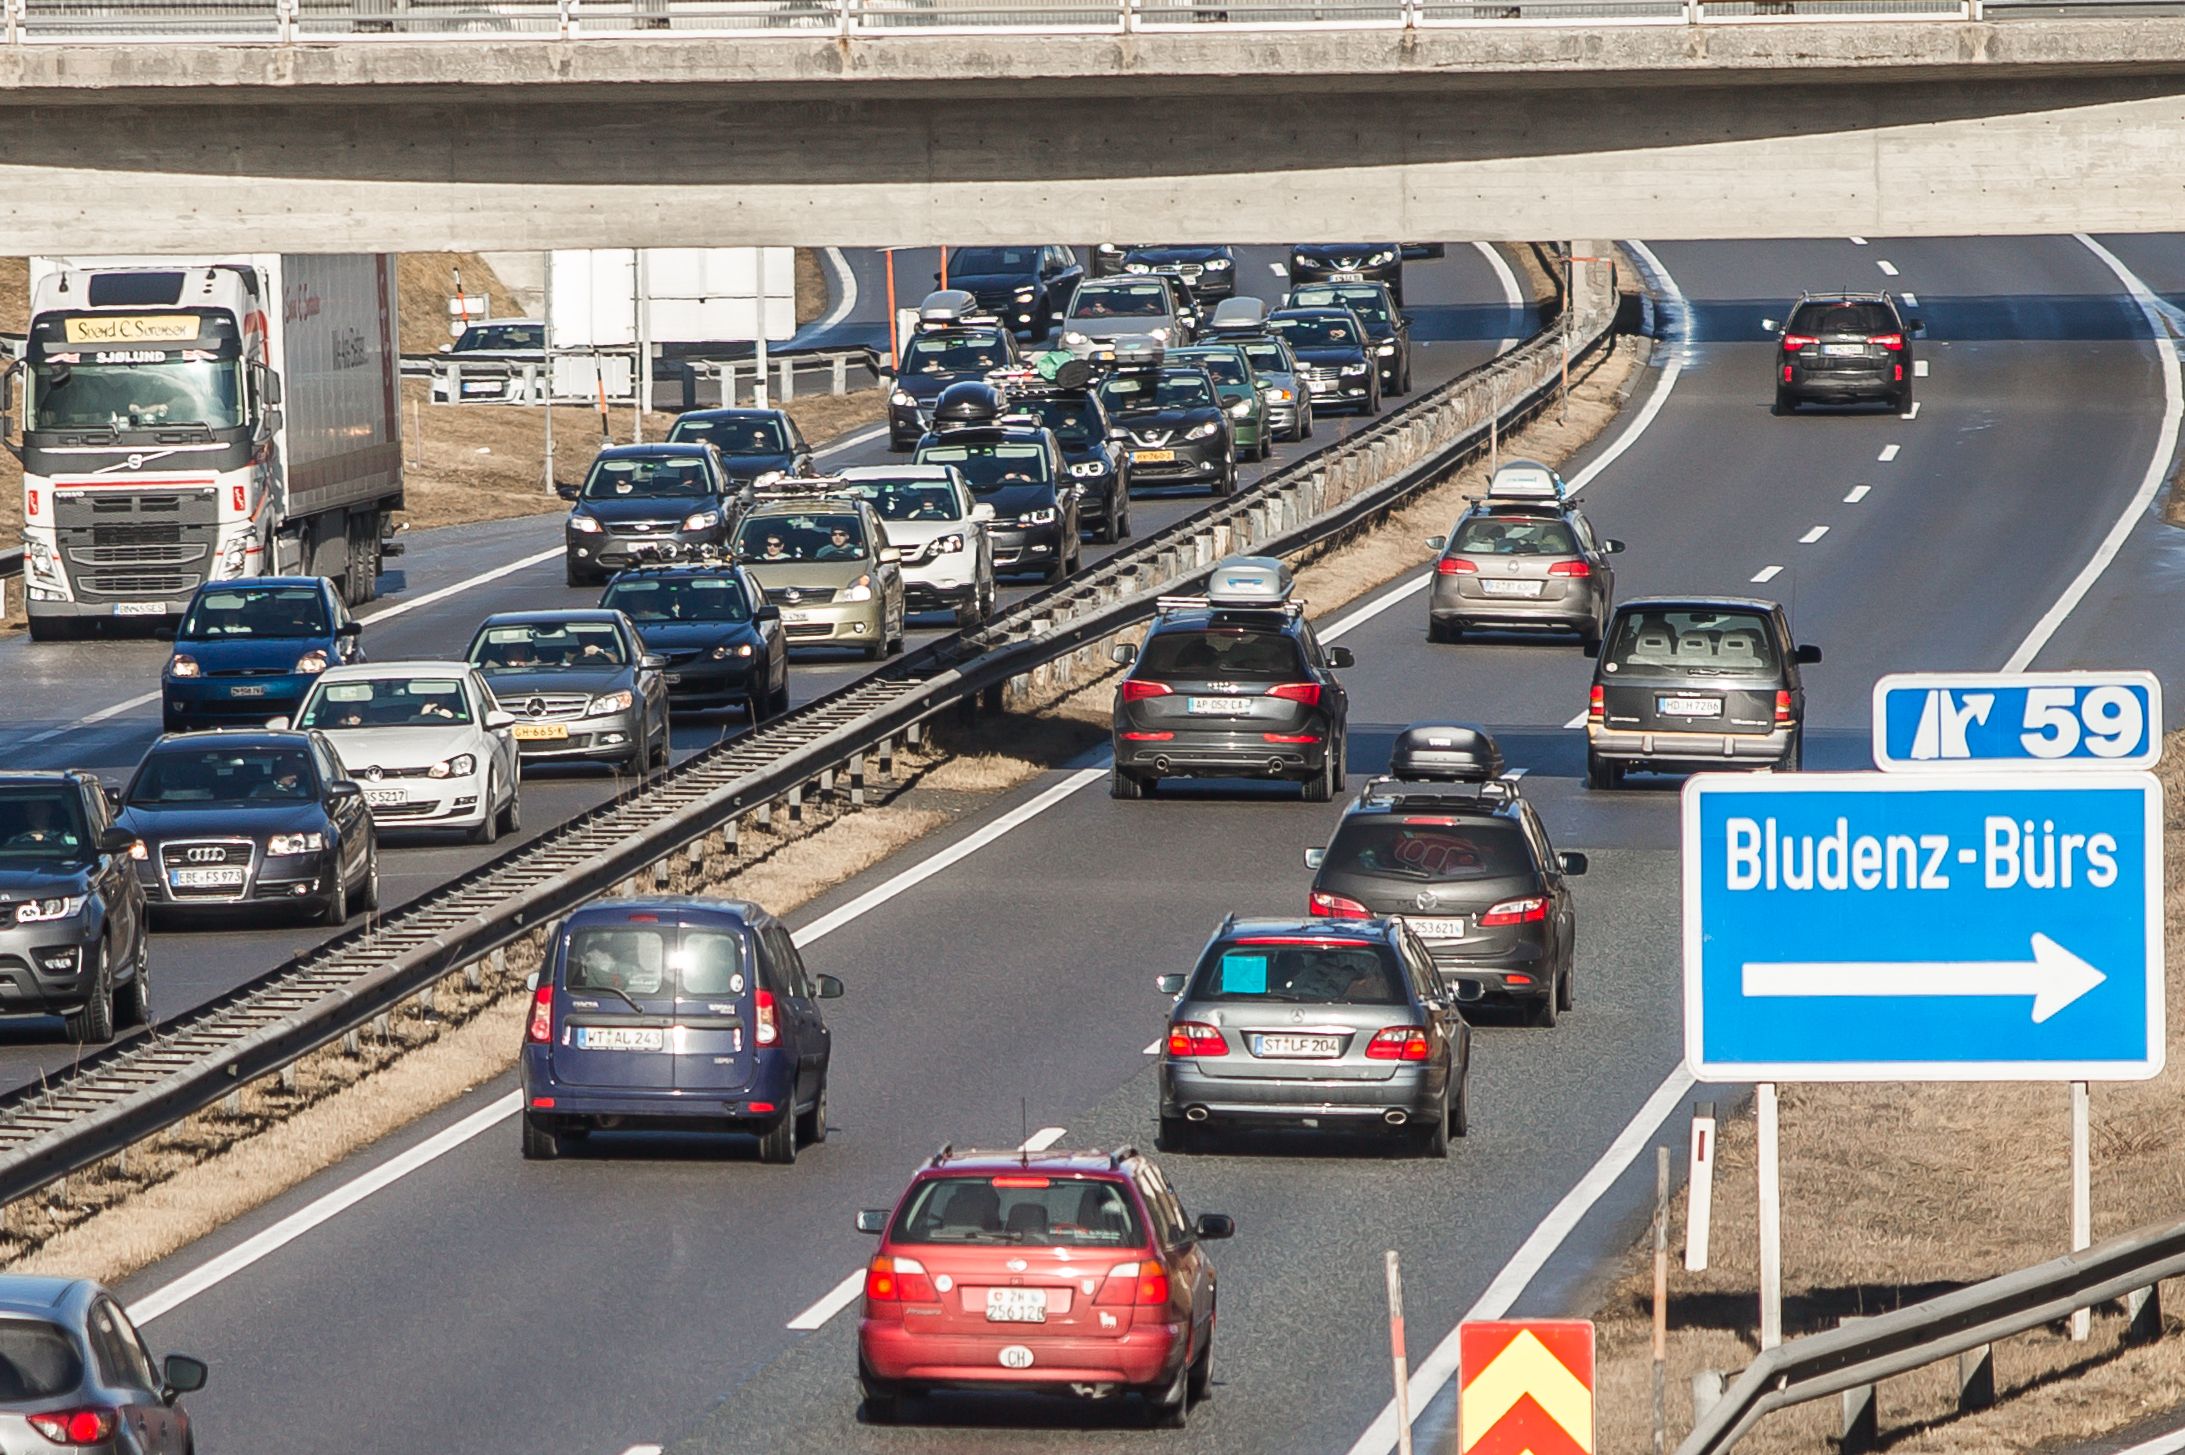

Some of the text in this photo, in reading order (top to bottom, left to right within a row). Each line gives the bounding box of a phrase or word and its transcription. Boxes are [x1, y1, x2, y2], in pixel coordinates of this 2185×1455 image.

[2020, 686, 2143, 758] 59
[378, 791, 405, 802] 5217
[1007, 1350, 1026, 1366] CH
